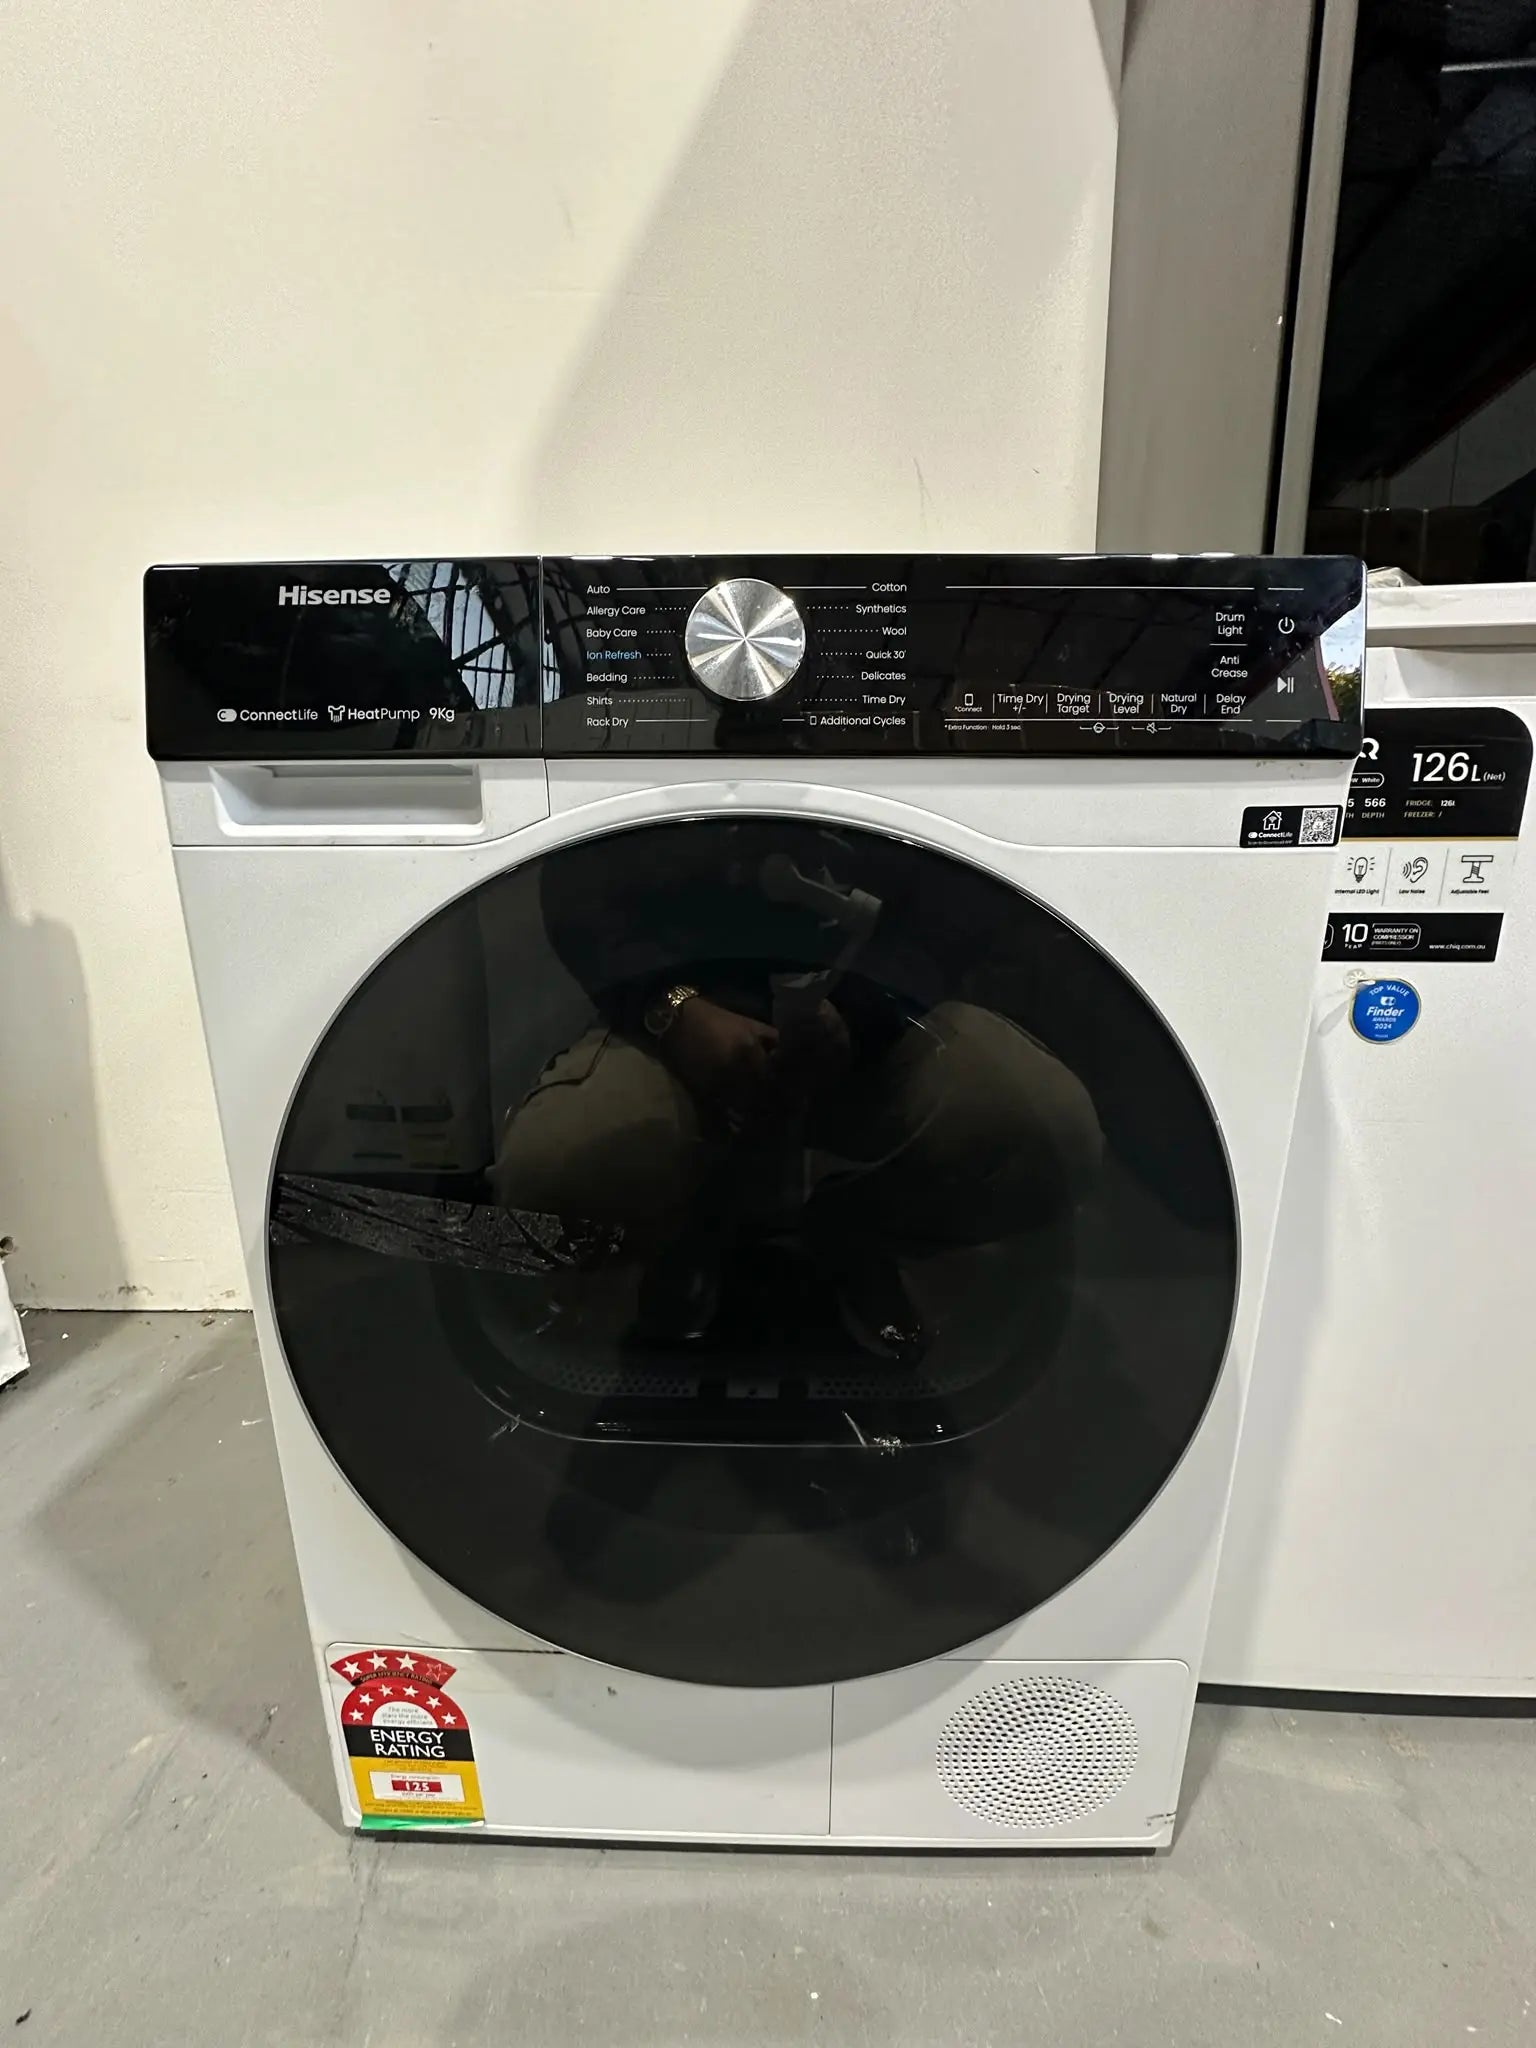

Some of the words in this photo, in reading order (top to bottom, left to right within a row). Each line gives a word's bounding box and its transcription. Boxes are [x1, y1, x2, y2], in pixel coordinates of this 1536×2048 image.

[586, 584, 610, 594] Auto
[872, 582, 907, 592] Cotton
[278, 586, 391, 606] Hisense
[586, 605, 620, 616] Allergy
[621, 606, 646, 615] Care
[856, 604, 907, 615] Synthetics
[1215, 612, 1245, 622] Drum
[586, 628, 610, 640] Baby
[612, 628, 638, 638] Care
[882, 626, 907, 636] Wool
[1218, 625, 1243, 636] Light
[586, 650, 602, 660] Ion
[605, 650, 642, 660] Refresh
[866, 650, 892, 660] Quick
[1220, 655, 1240, 665] Anti
[586, 672, 628, 684] Bedding
[861, 671, 906, 681] Delicates
[1211, 668, 1248, 678] Crease
[586, 696, 613, 706] Shirts
[862, 695, 886, 704] Time
[888, 695, 906, 706] Dry
[997, 693, 1023, 704] Time
[1026, 693, 1044, 706] Dry
[1057, 693, 1091, 704] Drying
[1109, 693, 1144, 705] Drying
[1161, 693, 1197, 702] Natural
[1216, 694, 1246, 705] Delay
[240, 708, 318, 721] ConnectLife
[348, 707, 420, 722] HeatPump
[429, 707, 455, 722] 9Kg
[1013, 704, 1027, 714] +/-
[1057, 704, 1090, 715] Target
[1114, 705, 1140, 714] Level
[1170, 704, 1187, 714] Dry
[1221, 705, 1240, 714] End
[586, 717, 610, 727] Rack
[612, 717, 629, 729] Dry
[820, 716, 871, 726] Additional
[873, 716, 906, 728] Cycles
[1483, 771, 1506, 782] (Net)
[1364, 798, 1386, 807] 566
[1342, 923, 1369, 943] 10
[1369, 986, 1384, 996] TOP
[1386, 984, 1410, 997] VALUE
[1366, 1006, 1405, 1016] Finder
[370, 1729, 444, 1744] ENERGY
[375, 1744, 445, 1758] RATING
[406, 1782, 429, 1791] 125
